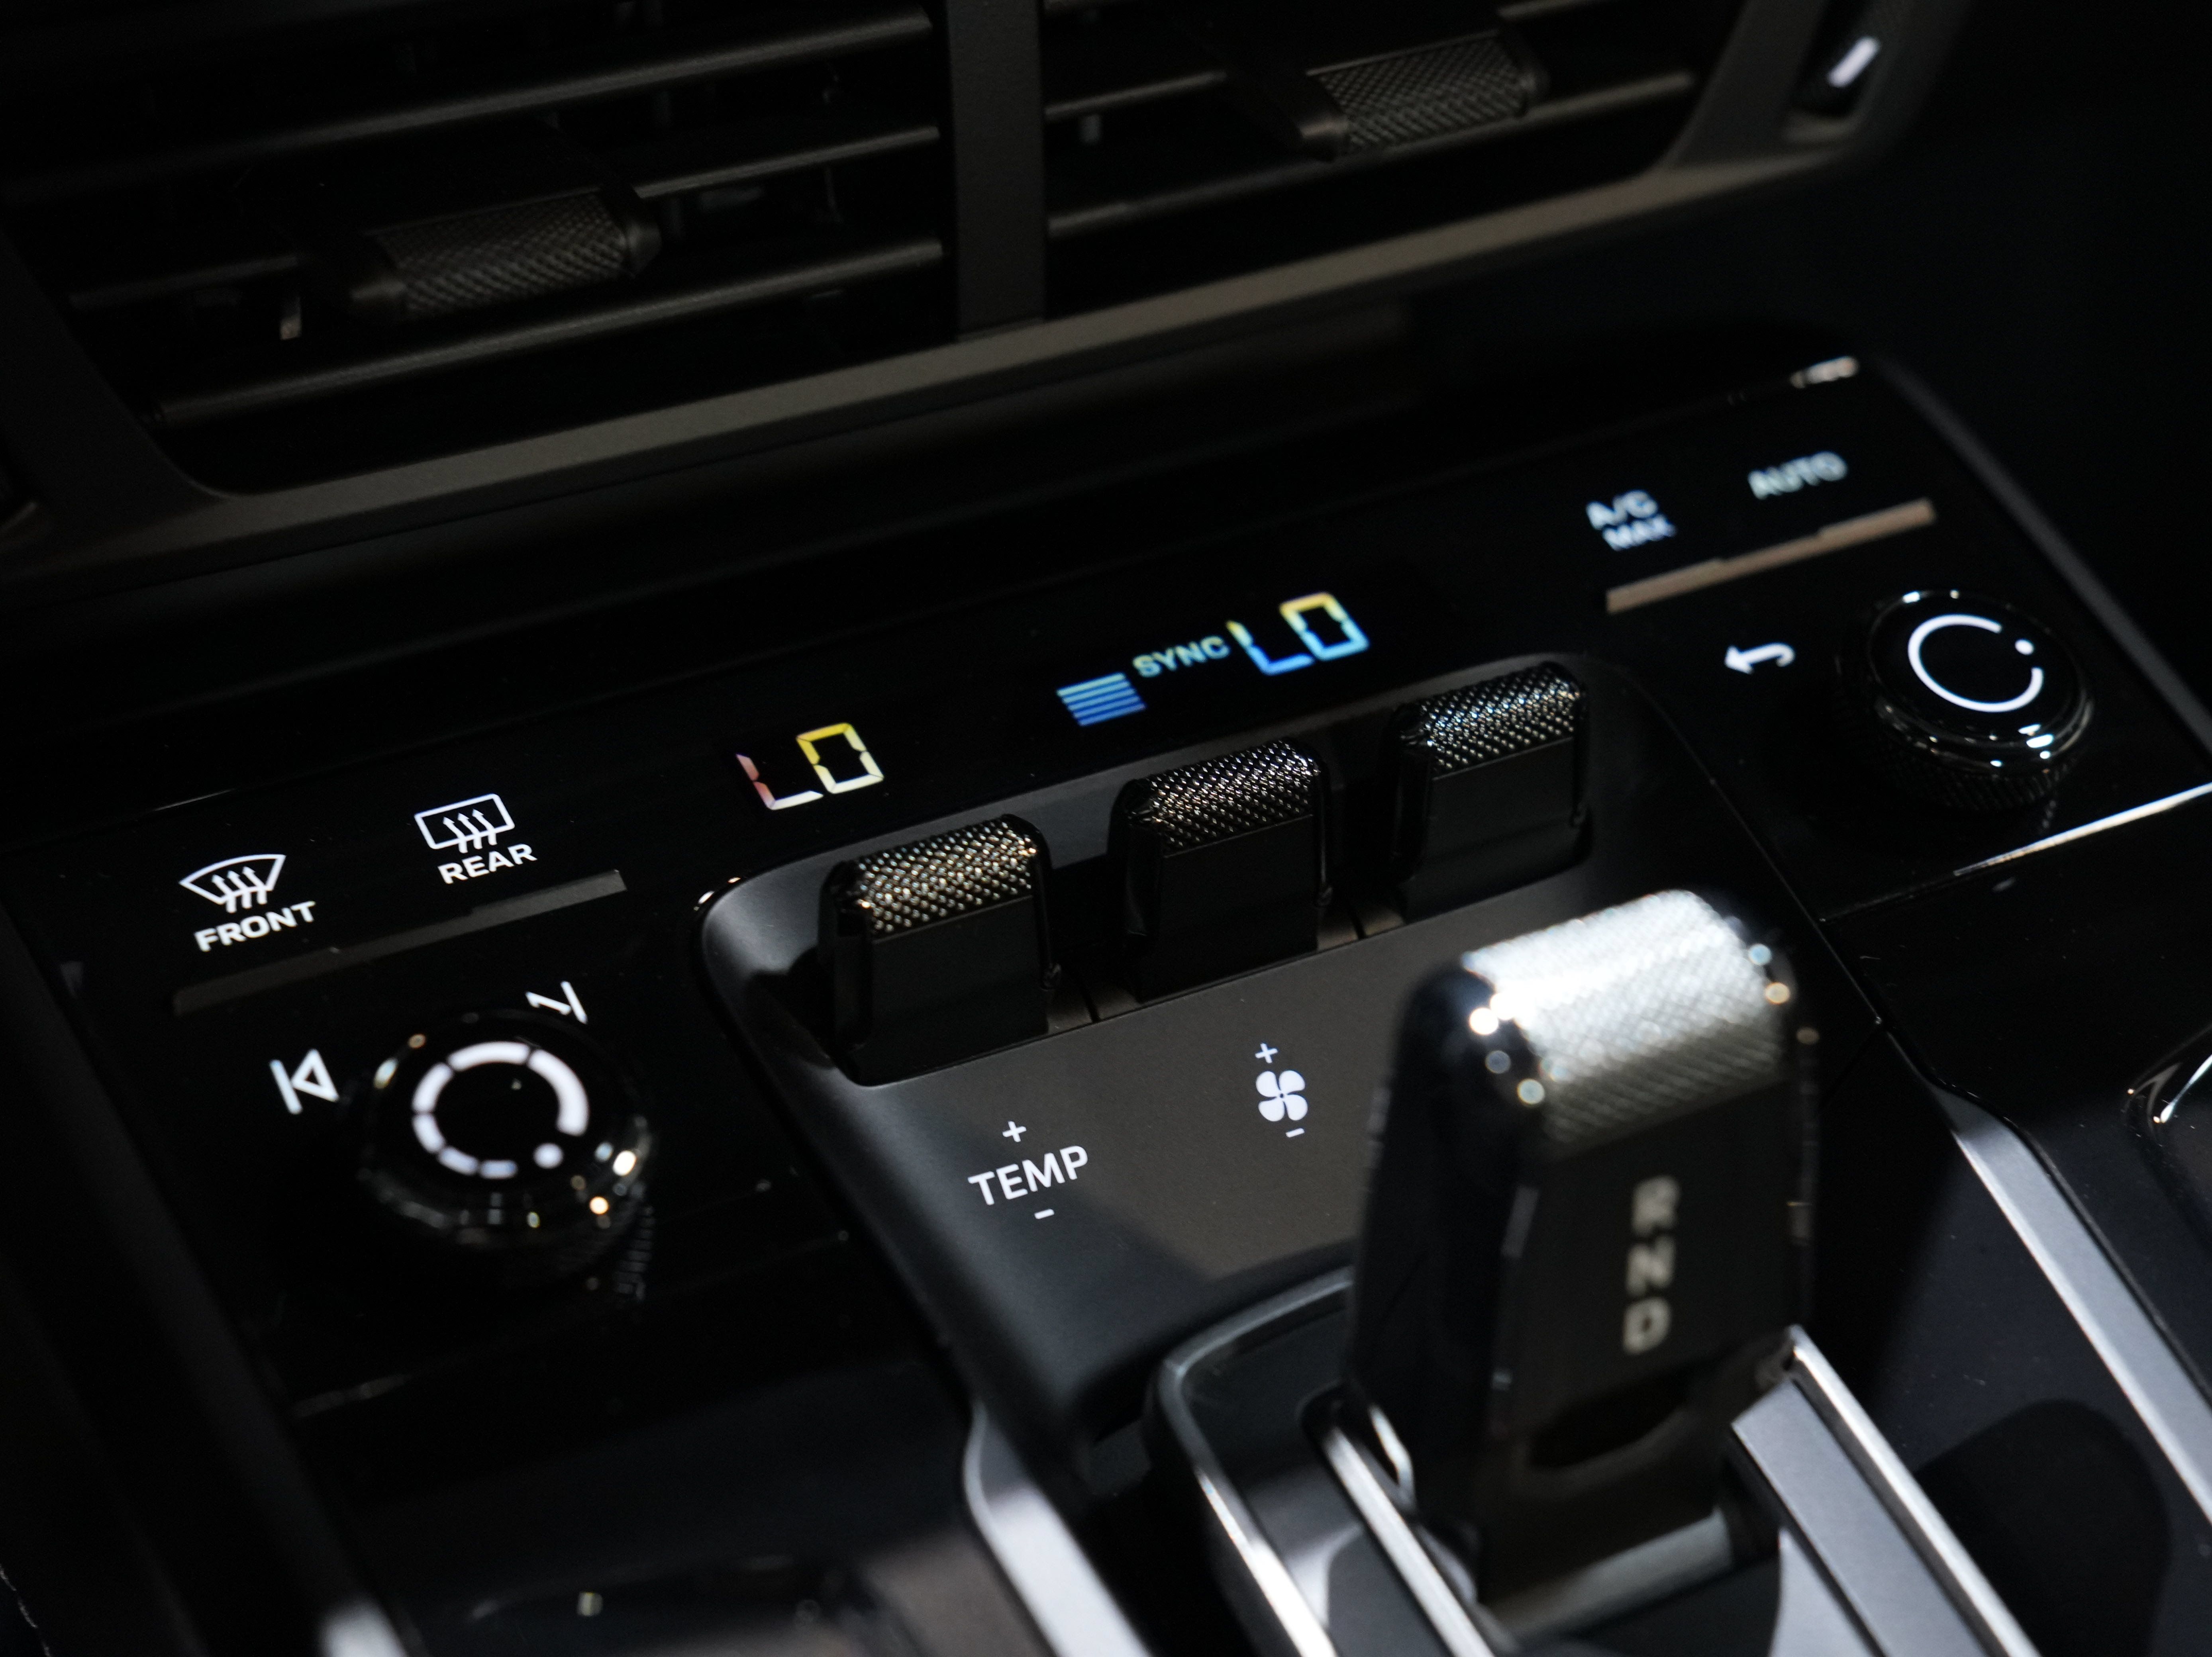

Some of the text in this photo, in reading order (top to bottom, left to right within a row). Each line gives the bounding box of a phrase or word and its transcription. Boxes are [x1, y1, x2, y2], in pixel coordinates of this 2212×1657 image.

[1749, 452, 1847, 498] AUTO
[1586, 490, 1657, 529] A/C
[1603, 514, 1675, 550] MAX
[1133, 593, 1369, 677] SYNC LO
[736, 723, 884, 810] LO
[437, 843, 537, 884] REAR
[194, 901, 316, 952] FRONT
[967, 1145, 1088, 1205] TEMP
